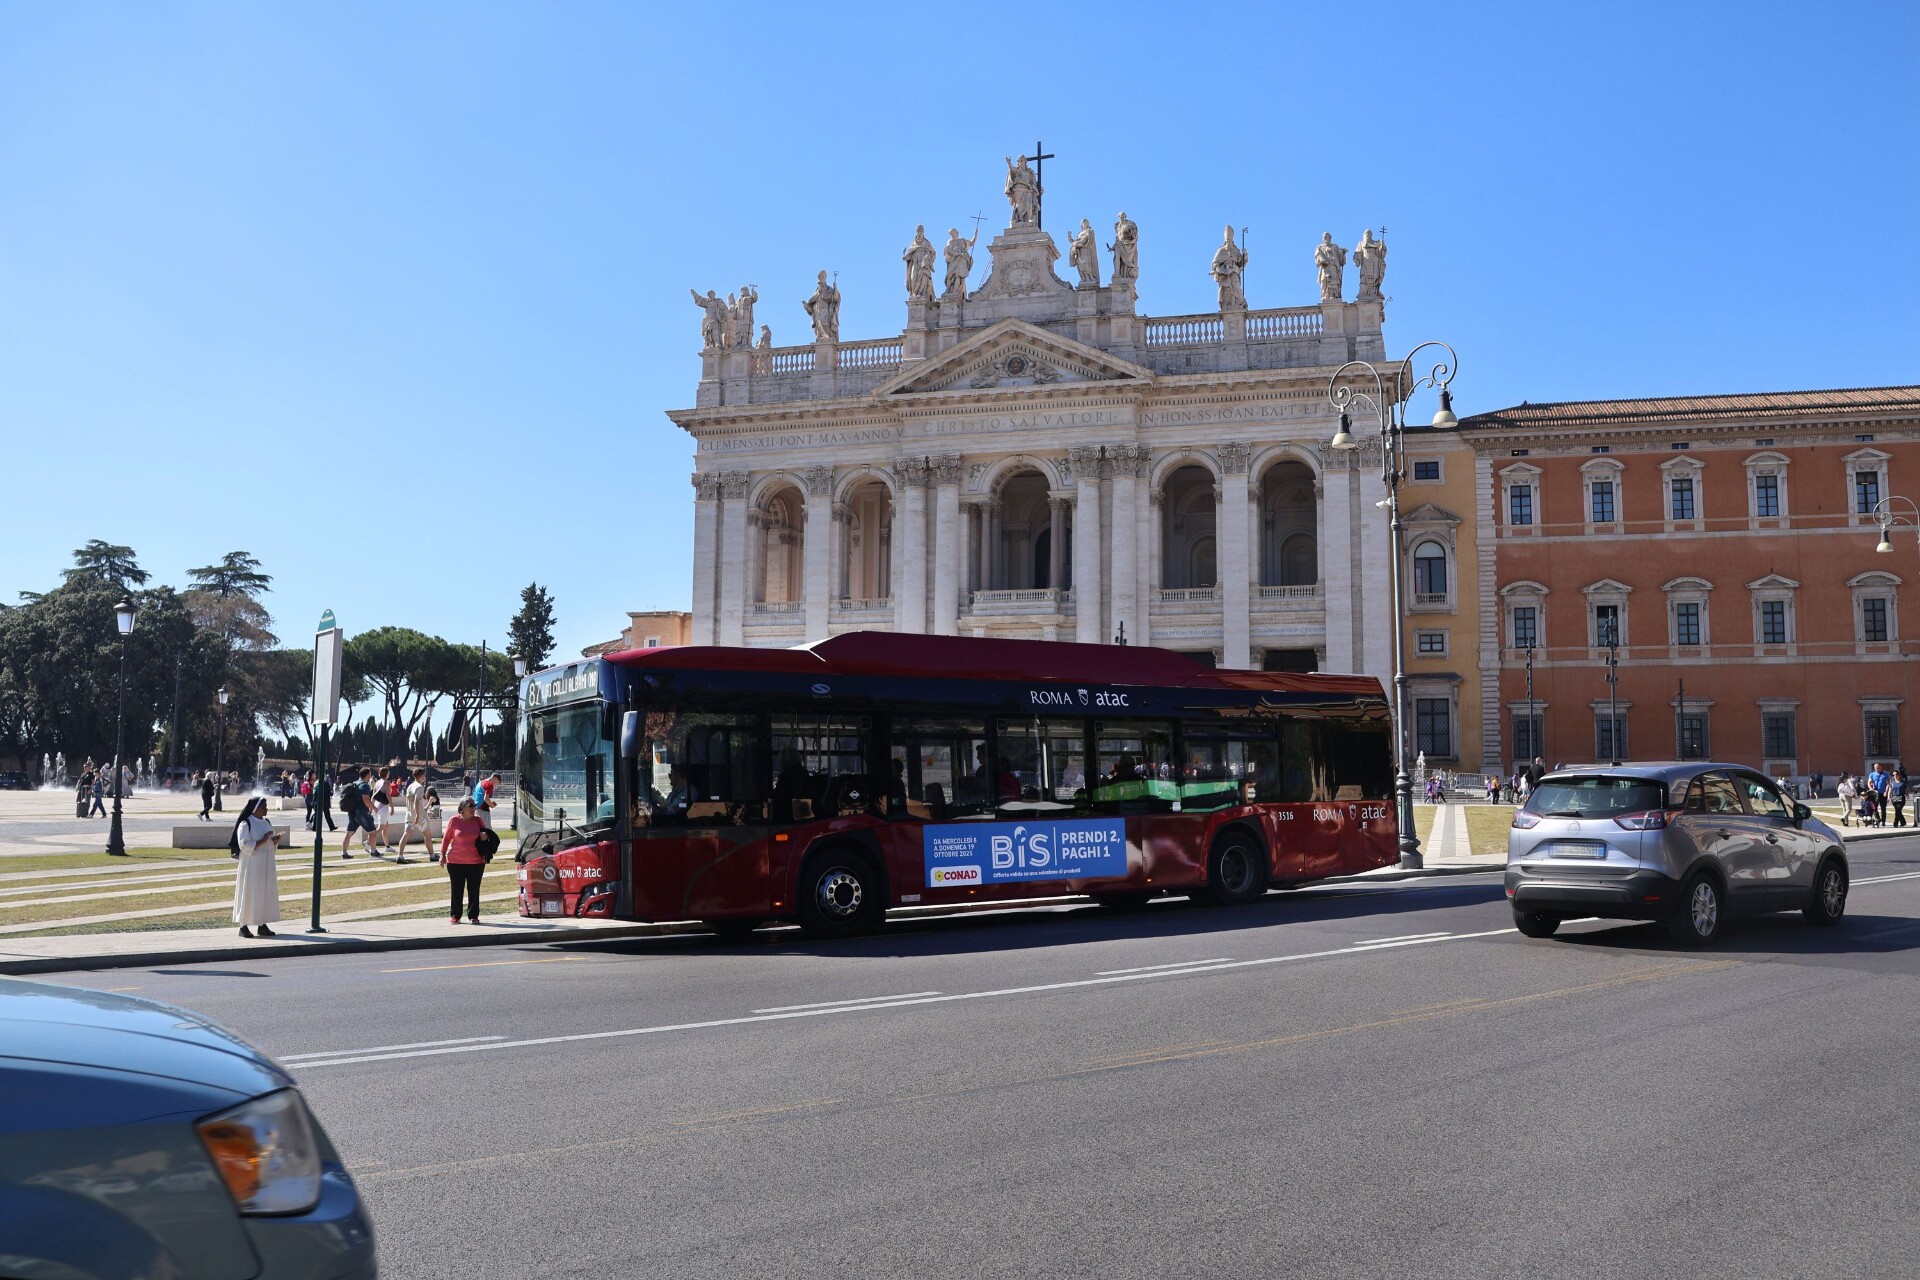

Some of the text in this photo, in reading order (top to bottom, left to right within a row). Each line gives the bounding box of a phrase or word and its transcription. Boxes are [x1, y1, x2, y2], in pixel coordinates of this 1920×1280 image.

[528, 680, 542, 706] 87
[1030, 690, 1129, 706] ROMA atac
[1278, 811, 1294, 821] 3516
[1313, 807, 1386, 821] ROMA atac
[1062, 830, 1121, 844] PRENDI 2,
[1062, 846, 1110, 859] PAGHI 1
[584, 866, 602, 878] atac
[944, 870, 978, 880] CONAD
